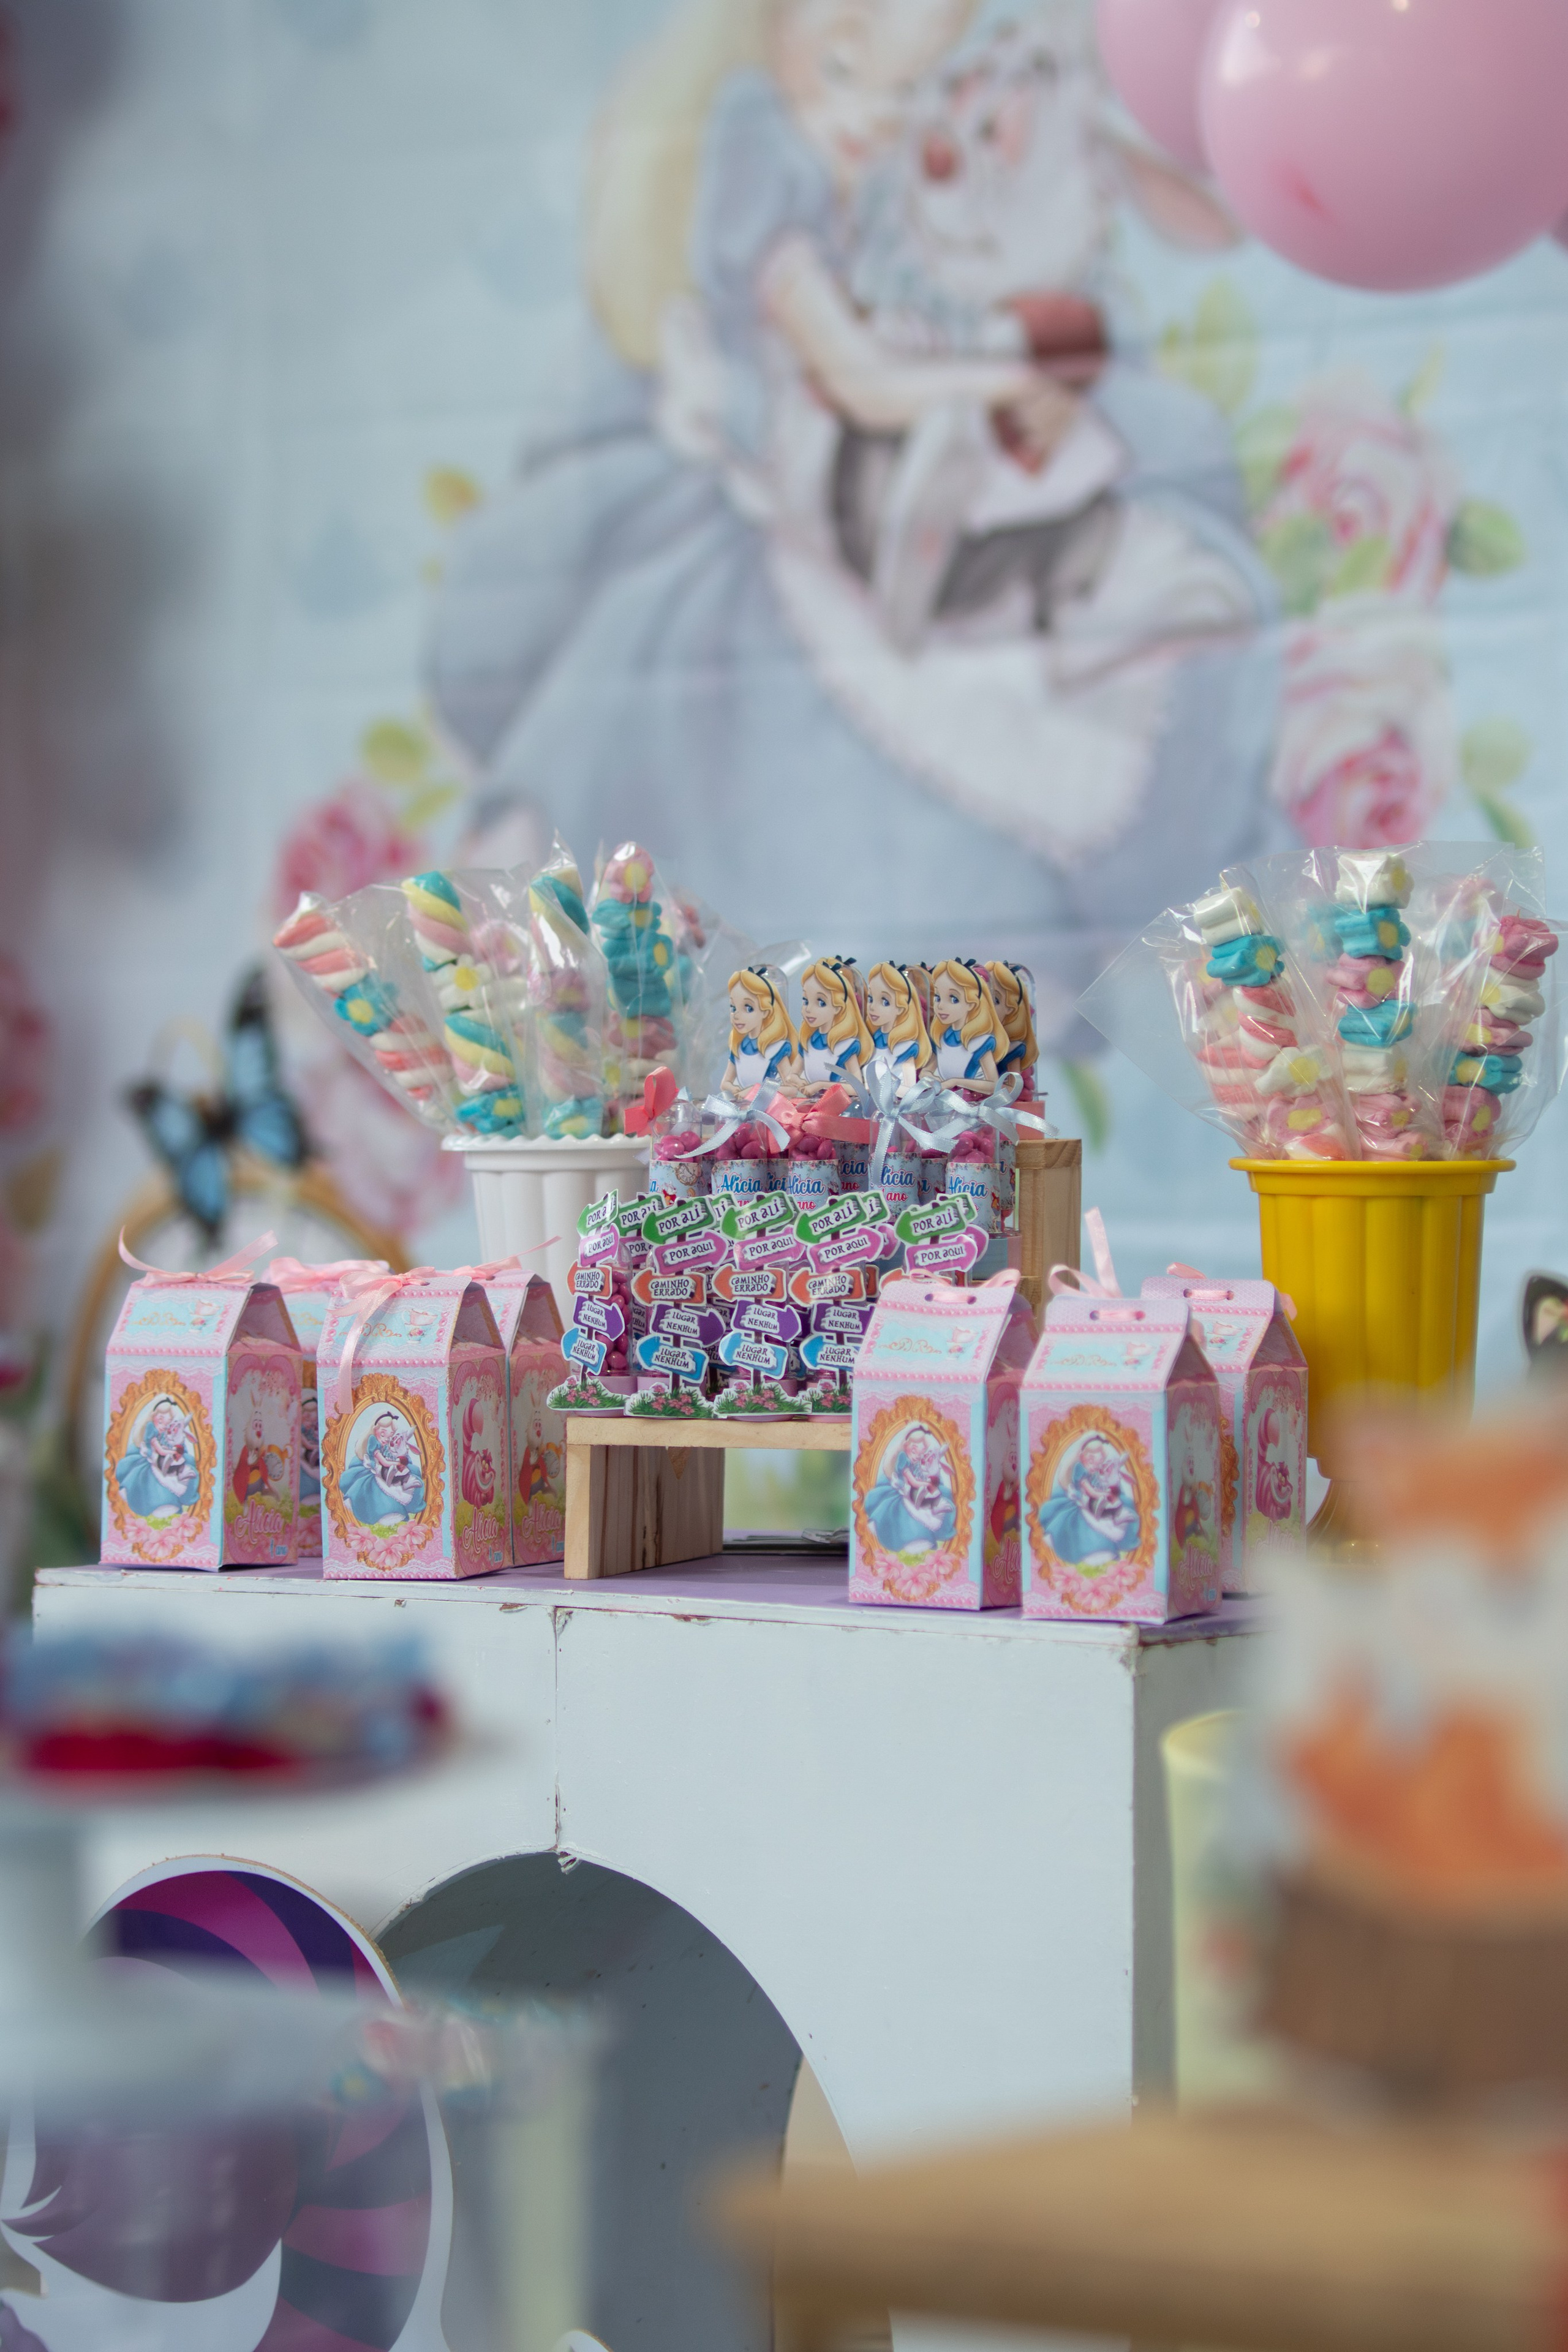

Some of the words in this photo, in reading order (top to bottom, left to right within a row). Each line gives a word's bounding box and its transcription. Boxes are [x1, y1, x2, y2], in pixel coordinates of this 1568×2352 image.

[881, 1165, 915, 1186] licia
[717, 1174, 763, 1194] Alicia
[886, 1192, 908, 1202] ano
[621, 1211, 641, 1225] POR
[658, 1216, 680, 1233] POR
[738, 1212, 760, 1228] POR
[812, 1216, 834, 1232] POR
[913, 1218, 935, 1233] POR
[589, 1241, 601, 1253] POR
[629, 1242, 647, 1254] POR
[749, 1243, 771, 1256] POR
[824, 1245, 845, 1259] POR
[669, 1248, 690, 1261] POR
[921, 1251, 942, 1263] POR
[235, 1499, 284, 1544] Alicia
[462, 1507, 499, 1554] Alicia
